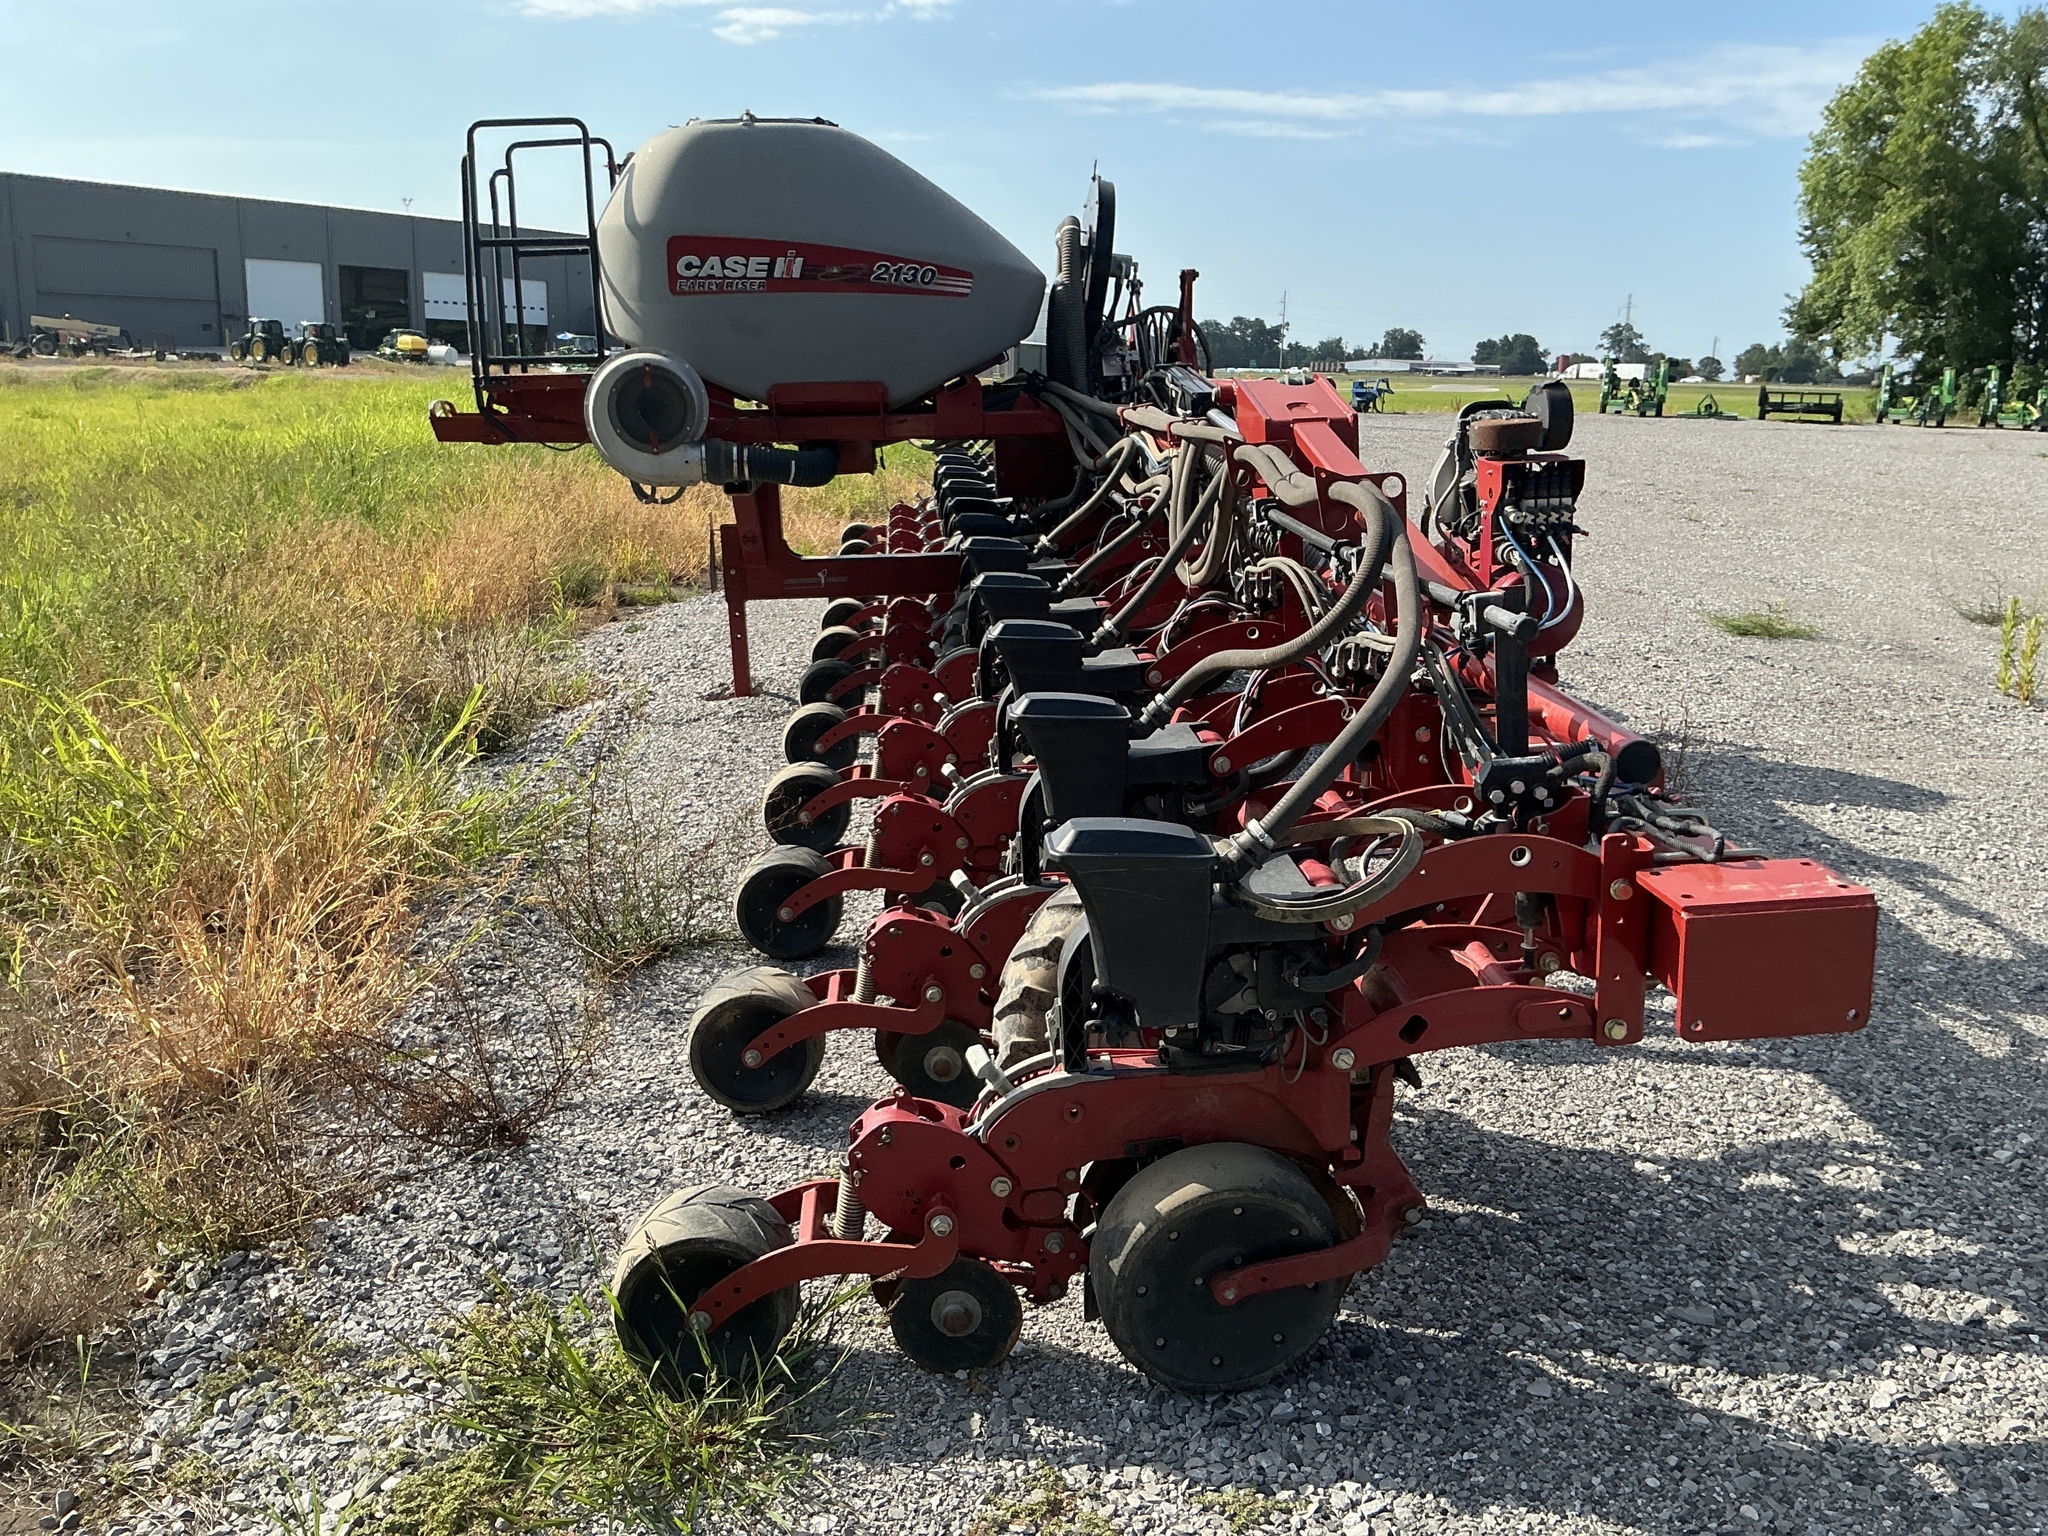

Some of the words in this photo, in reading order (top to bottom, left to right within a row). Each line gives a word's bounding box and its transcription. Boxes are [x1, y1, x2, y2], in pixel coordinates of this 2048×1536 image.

[676, 255, 771, 278] CASE
[870, 262, 938, 286] 2130
[677, 279, 722, 291] EARLY
[724, 279, 767, 291] RISER
